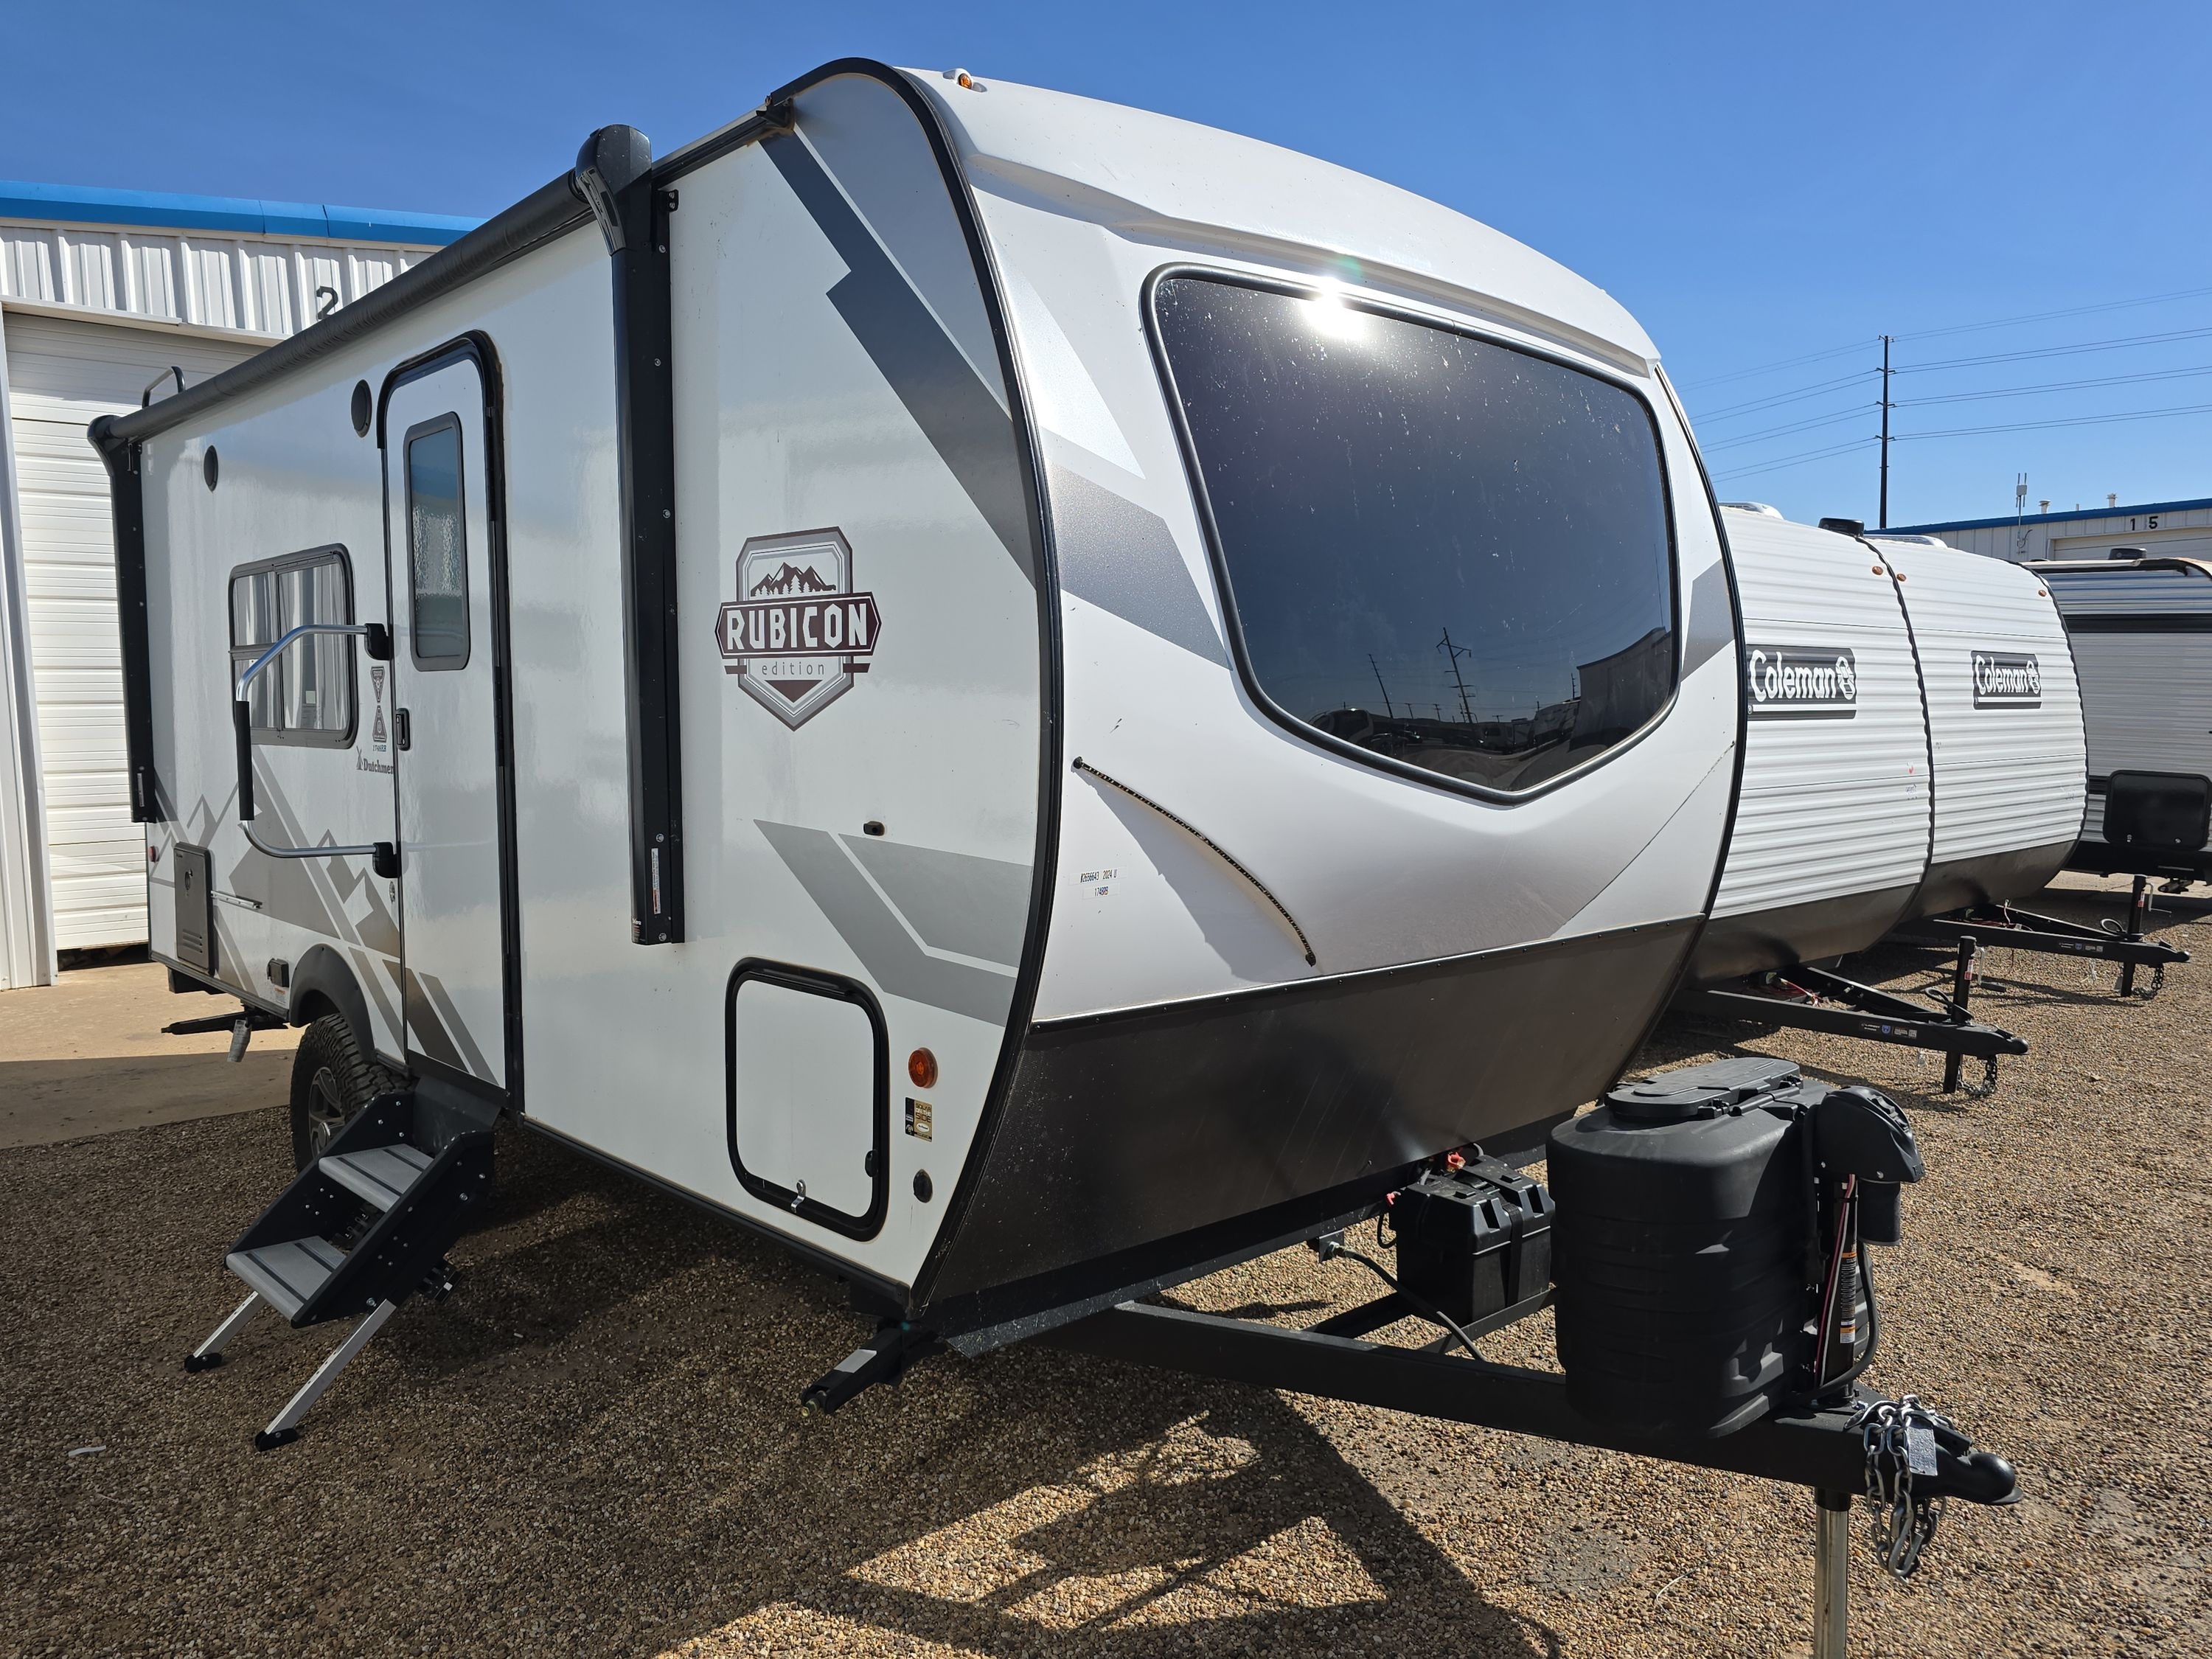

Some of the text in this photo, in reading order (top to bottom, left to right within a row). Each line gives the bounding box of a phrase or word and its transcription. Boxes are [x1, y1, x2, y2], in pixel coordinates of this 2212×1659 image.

[316, 286, 338, 319] 2
[727, 603, 867, 650] RUBICON
[762, 661, 824, 675] edition
[1750, 650, 1837, 701] Coleman
[1975, 655, 2028, 695] Coleman
[916, 1113, 931, 1123] SIDE
